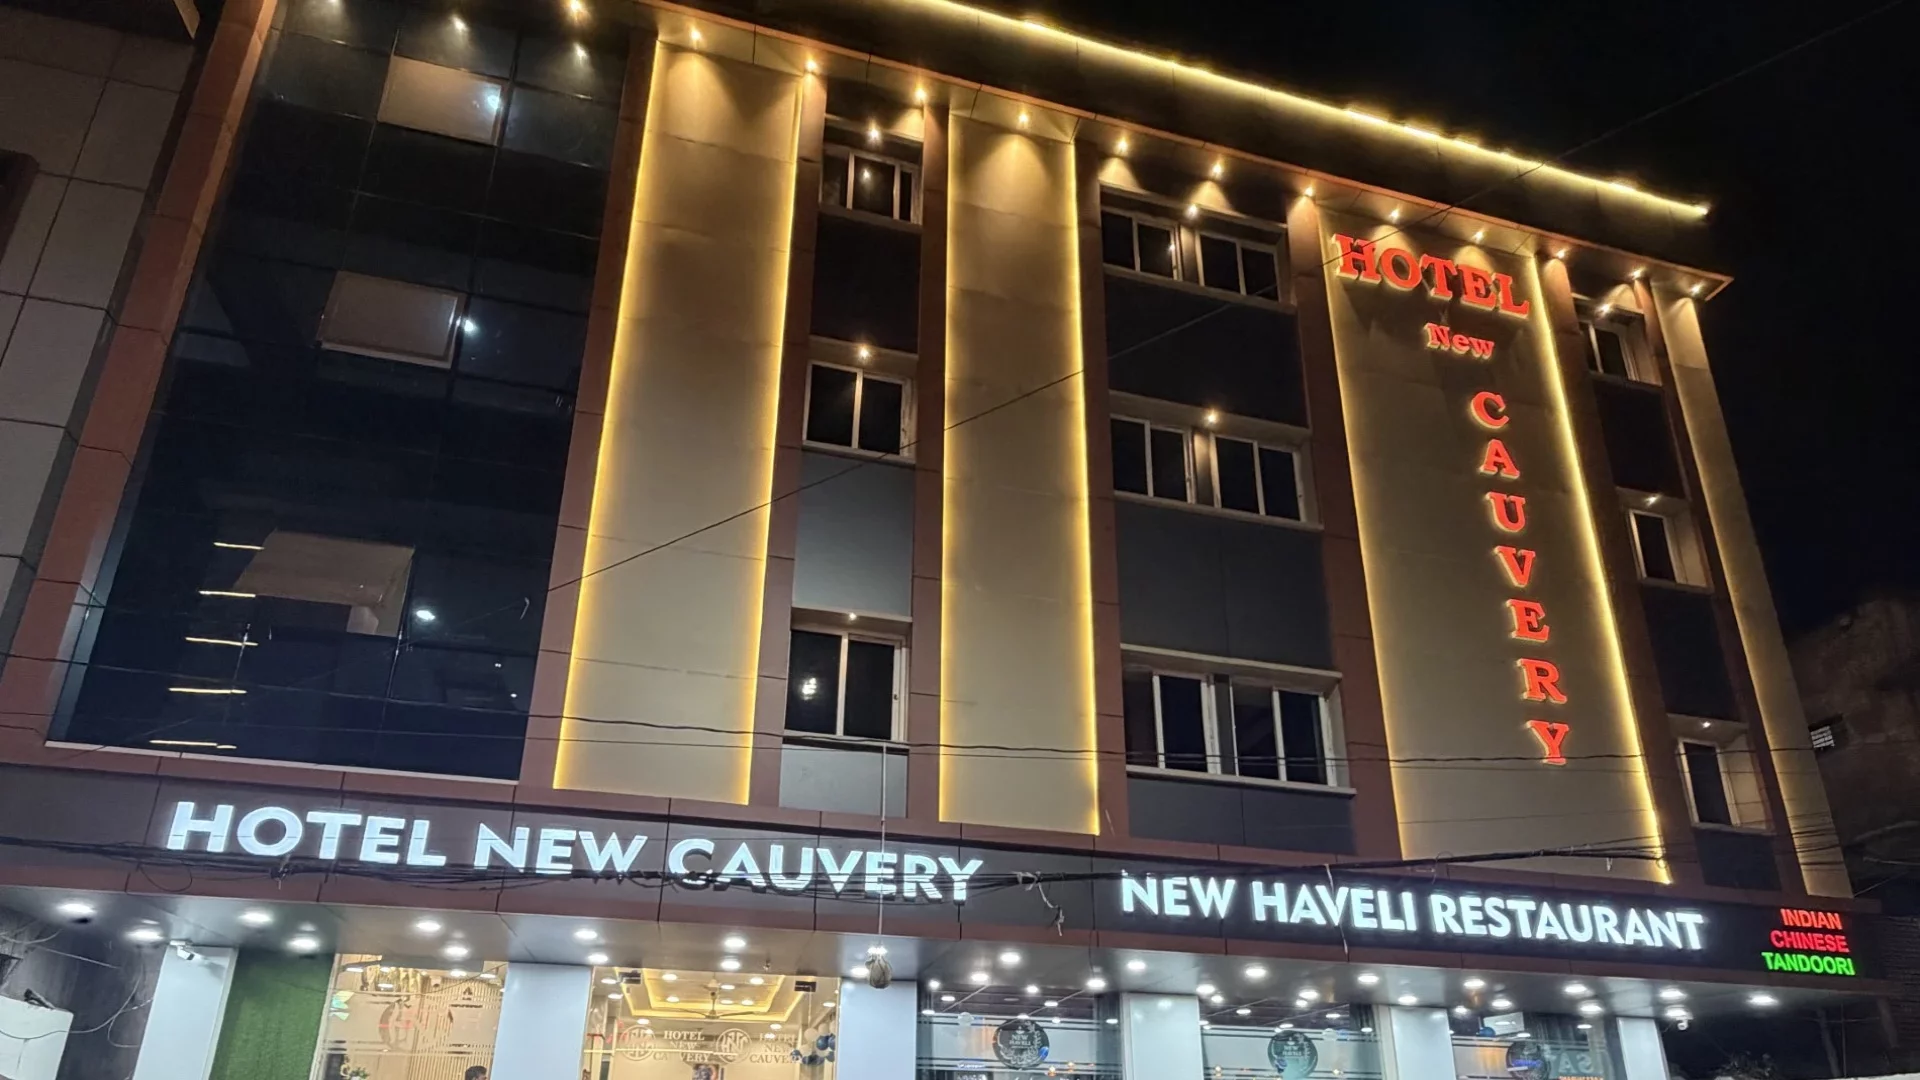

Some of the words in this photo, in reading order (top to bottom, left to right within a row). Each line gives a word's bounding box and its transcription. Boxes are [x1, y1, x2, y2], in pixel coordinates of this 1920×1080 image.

[1332, 233, 1529, 318] HOTEL
[1424, 323, 1494, 359] New
[1471, 391, 1569, 765] CAUVERY
[166, 801, 446, 867] HOTEL
[473, 822, 648, 875] NEW
[668, 838, 983, 903] CAUVERY
[1122, 870, 1236, 919] NEW
[1251, 880, 1418, 931] HAVELI
[1430, 893, 1703, 950] RESTAURANT
[1780, 908, 1843, 930] INDIAN
[1770, 930, 1850, 953] CHINESE
[1761, 951, 1856, 976] TANDOORI
[663, 1030, 705, 1041] HOTEL
